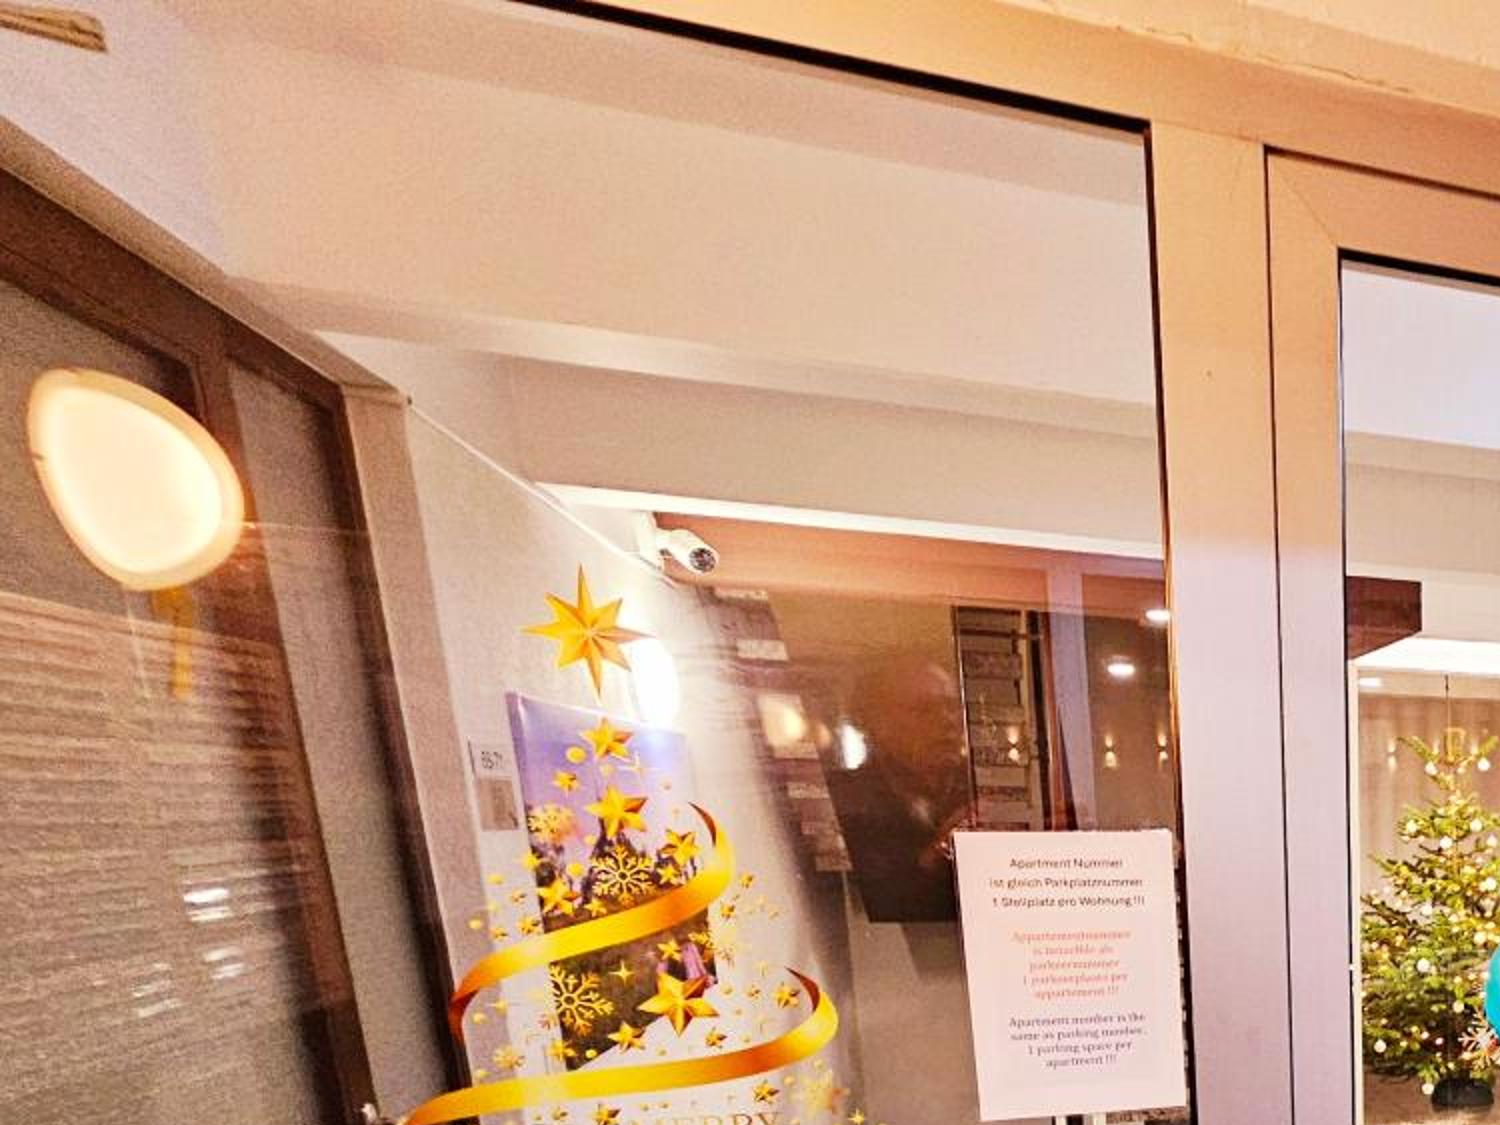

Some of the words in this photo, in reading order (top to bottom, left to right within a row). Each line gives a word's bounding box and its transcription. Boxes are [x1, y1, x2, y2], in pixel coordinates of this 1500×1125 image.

[1010, 858, 1071, 869] Apartment
[1073, 858, 1123, 868] Nummer
[990, 878, 1004, 888] ist
[1007, 877, 1042, 890] gleich
[1044, 877, 1143, 889] Parkplatznummer
[1057, 898, 1076, 908] pro
